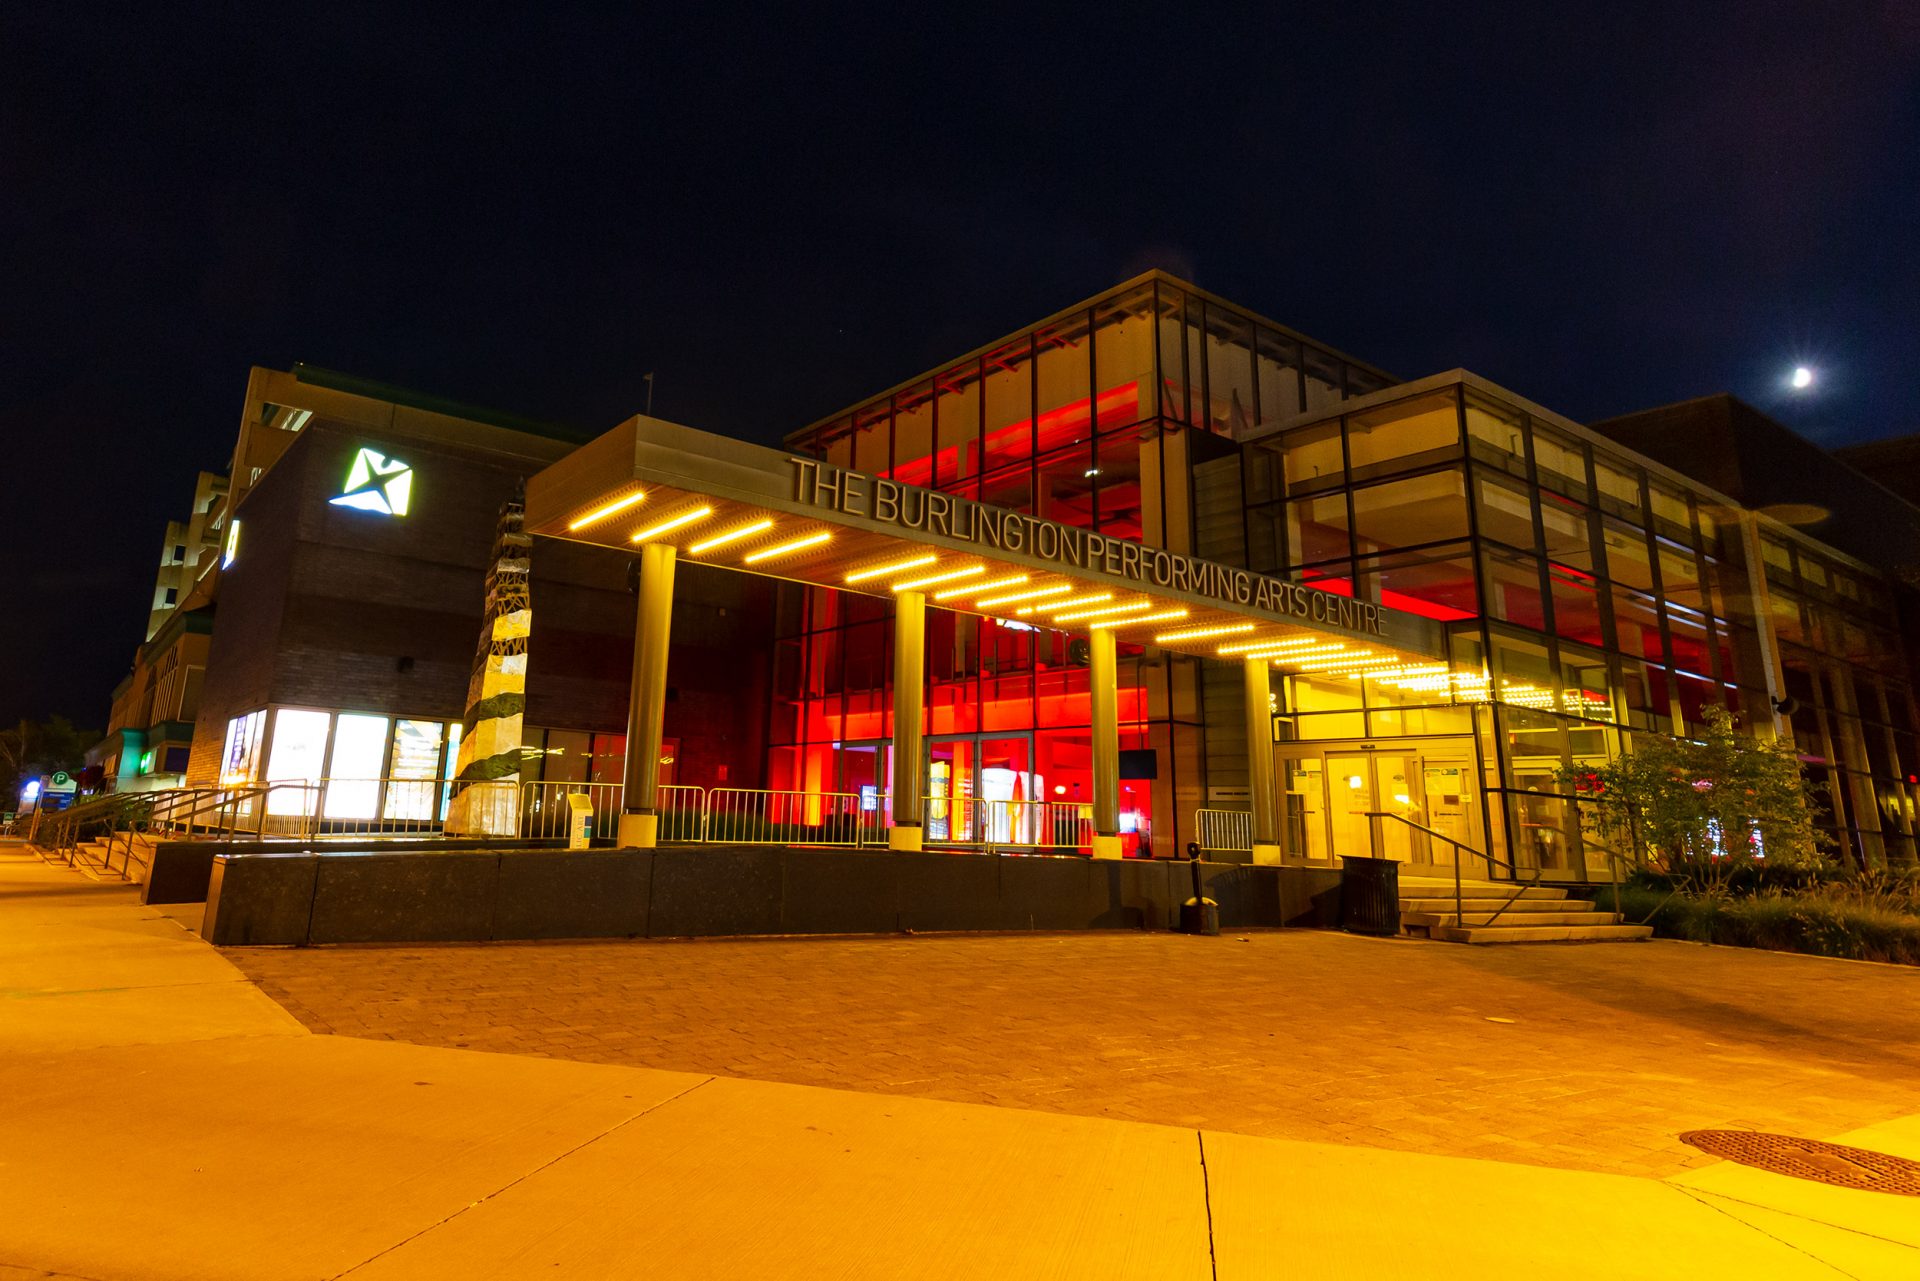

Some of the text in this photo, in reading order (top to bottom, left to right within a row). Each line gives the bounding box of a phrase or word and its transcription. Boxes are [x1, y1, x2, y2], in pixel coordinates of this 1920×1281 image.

[791, 457, 1389, 637] THE BURLINGTON PERFORMING ARTS CENTRE
[56, 774, 66, 783] P
